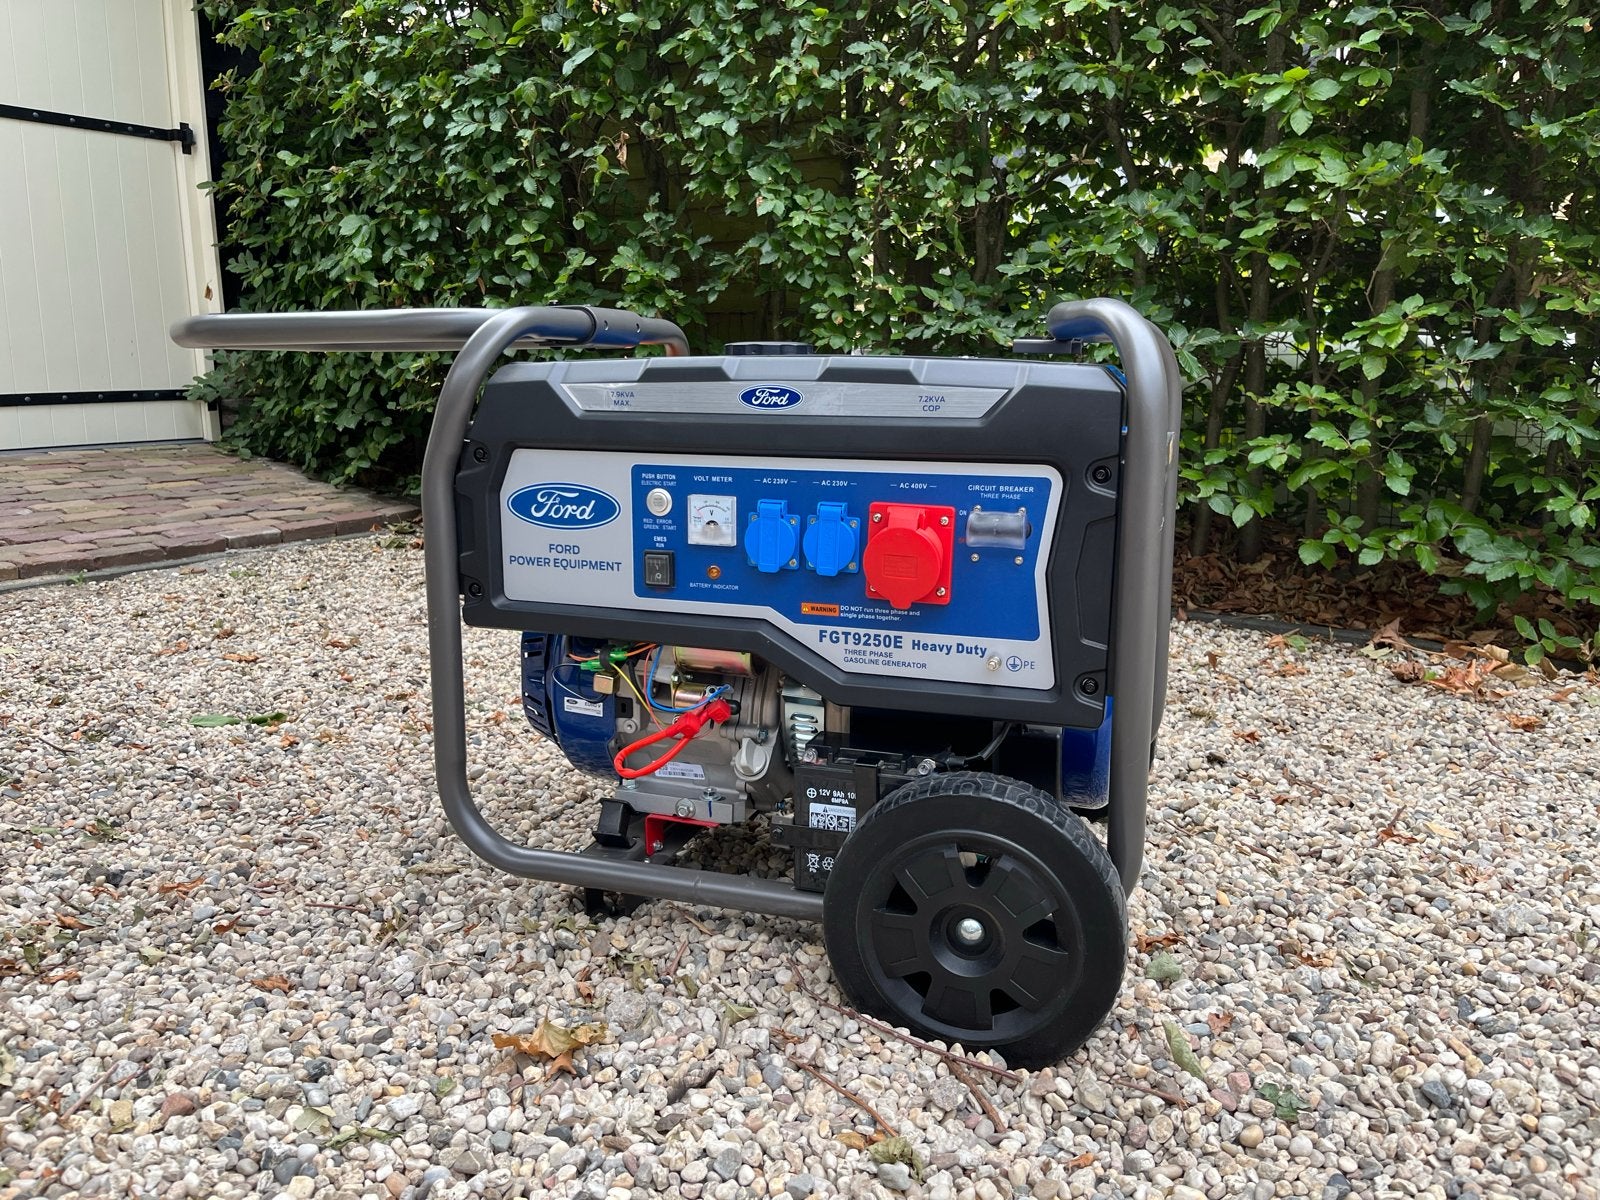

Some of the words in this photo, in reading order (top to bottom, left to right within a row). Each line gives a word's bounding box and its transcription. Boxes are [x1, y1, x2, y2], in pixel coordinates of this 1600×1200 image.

[751, 388, 789, 406] Ford
[918, 395, 945, 403] 7.2KVA
[922, 404, 941, 412] COP
[530, 489, 596, 520] Ford
[548, 543, 581, 555] FORD
[509, 555, 551, 567] POWER
[553, 558, 622, 572] EQUIPMENT
[810, 606, 837, 614] WARNING
[818, 629, 903, 649] FGT9250E
[912, 639, 952, 656] Heavy
[956, 643, 987, 658] Duty
[844, 648, 867, 656] THREE
[869, 650, 893, 658] PHASE
[843, 656, 880, 666] GASOLINE
[881, 659, 927, 669] GENERATOR
[1024, 660, 1036, 670] PE
[819, 788, 831, 796] 12V
